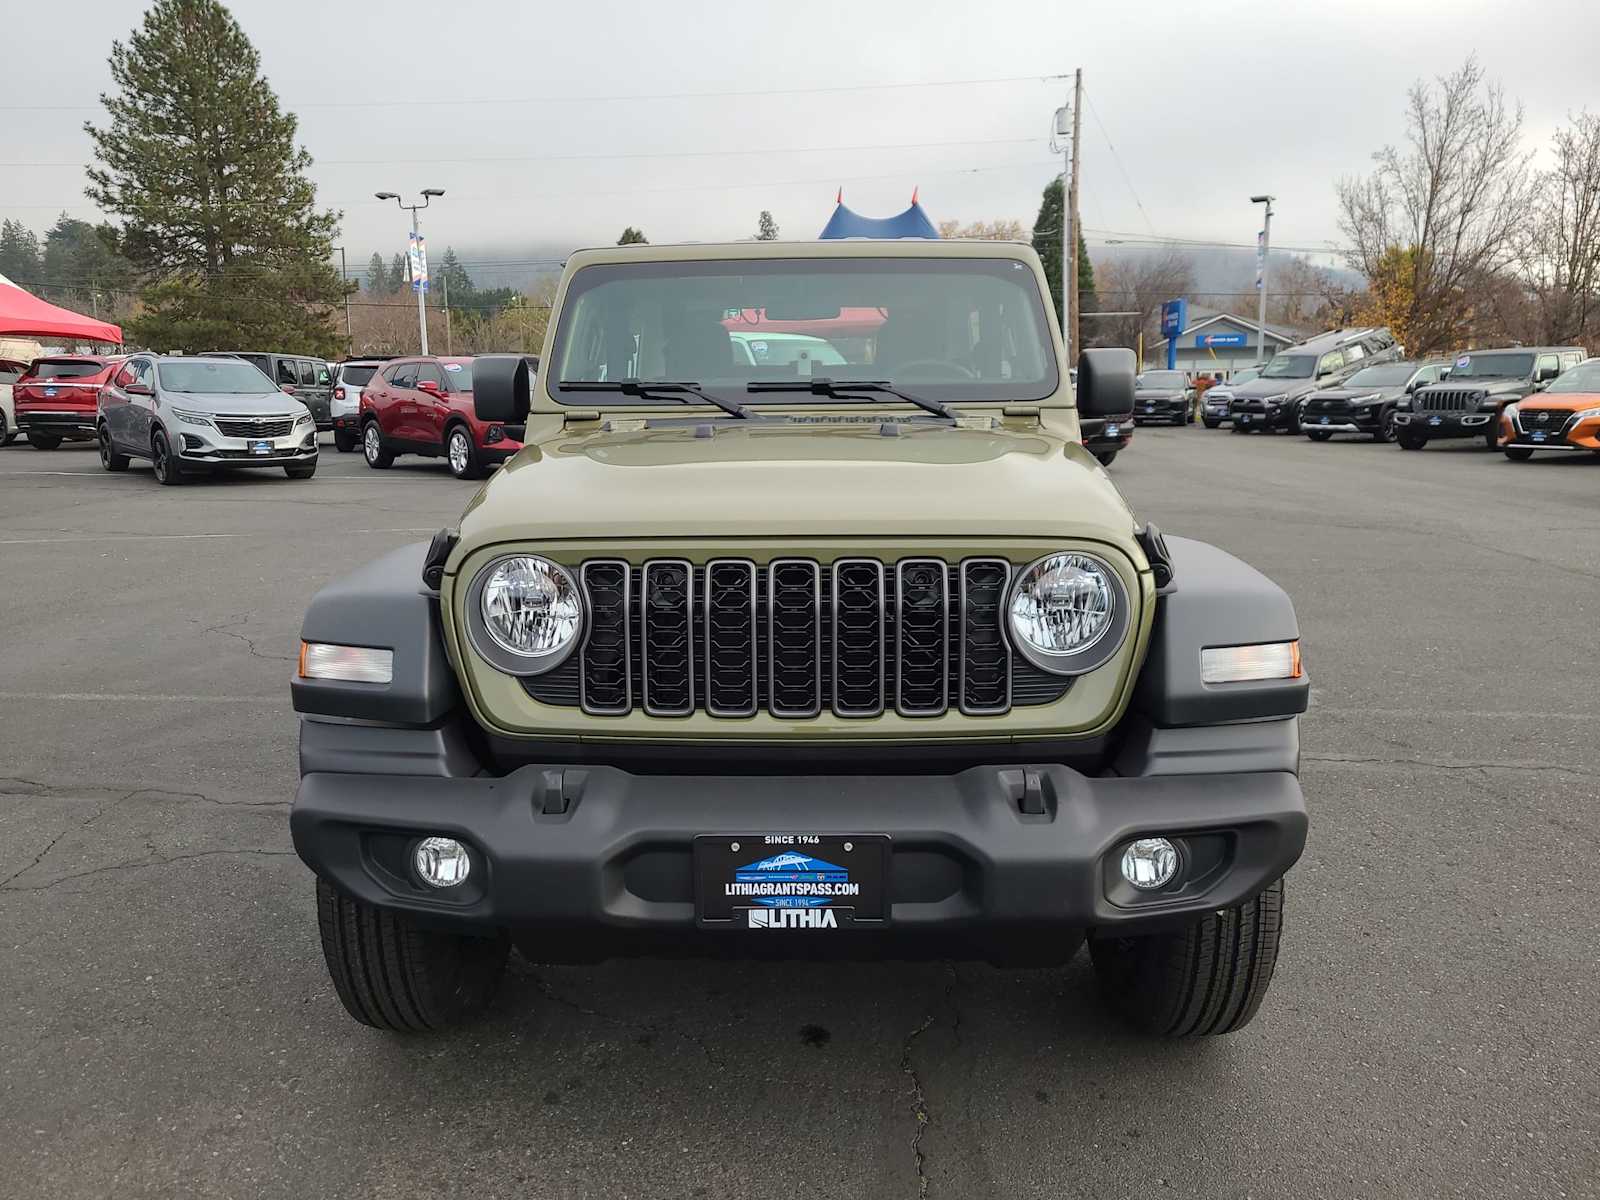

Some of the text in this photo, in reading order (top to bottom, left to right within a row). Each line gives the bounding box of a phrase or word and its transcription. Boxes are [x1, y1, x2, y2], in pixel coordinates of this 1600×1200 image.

[764, 836, 820, 844] SINCE 1946
[725, 883, 859, 896] LITHIAGRANTSPASS.COM
[775, 899, 809, 907] SINCE 1994
[768, 909, 838, 928] LITHIA
